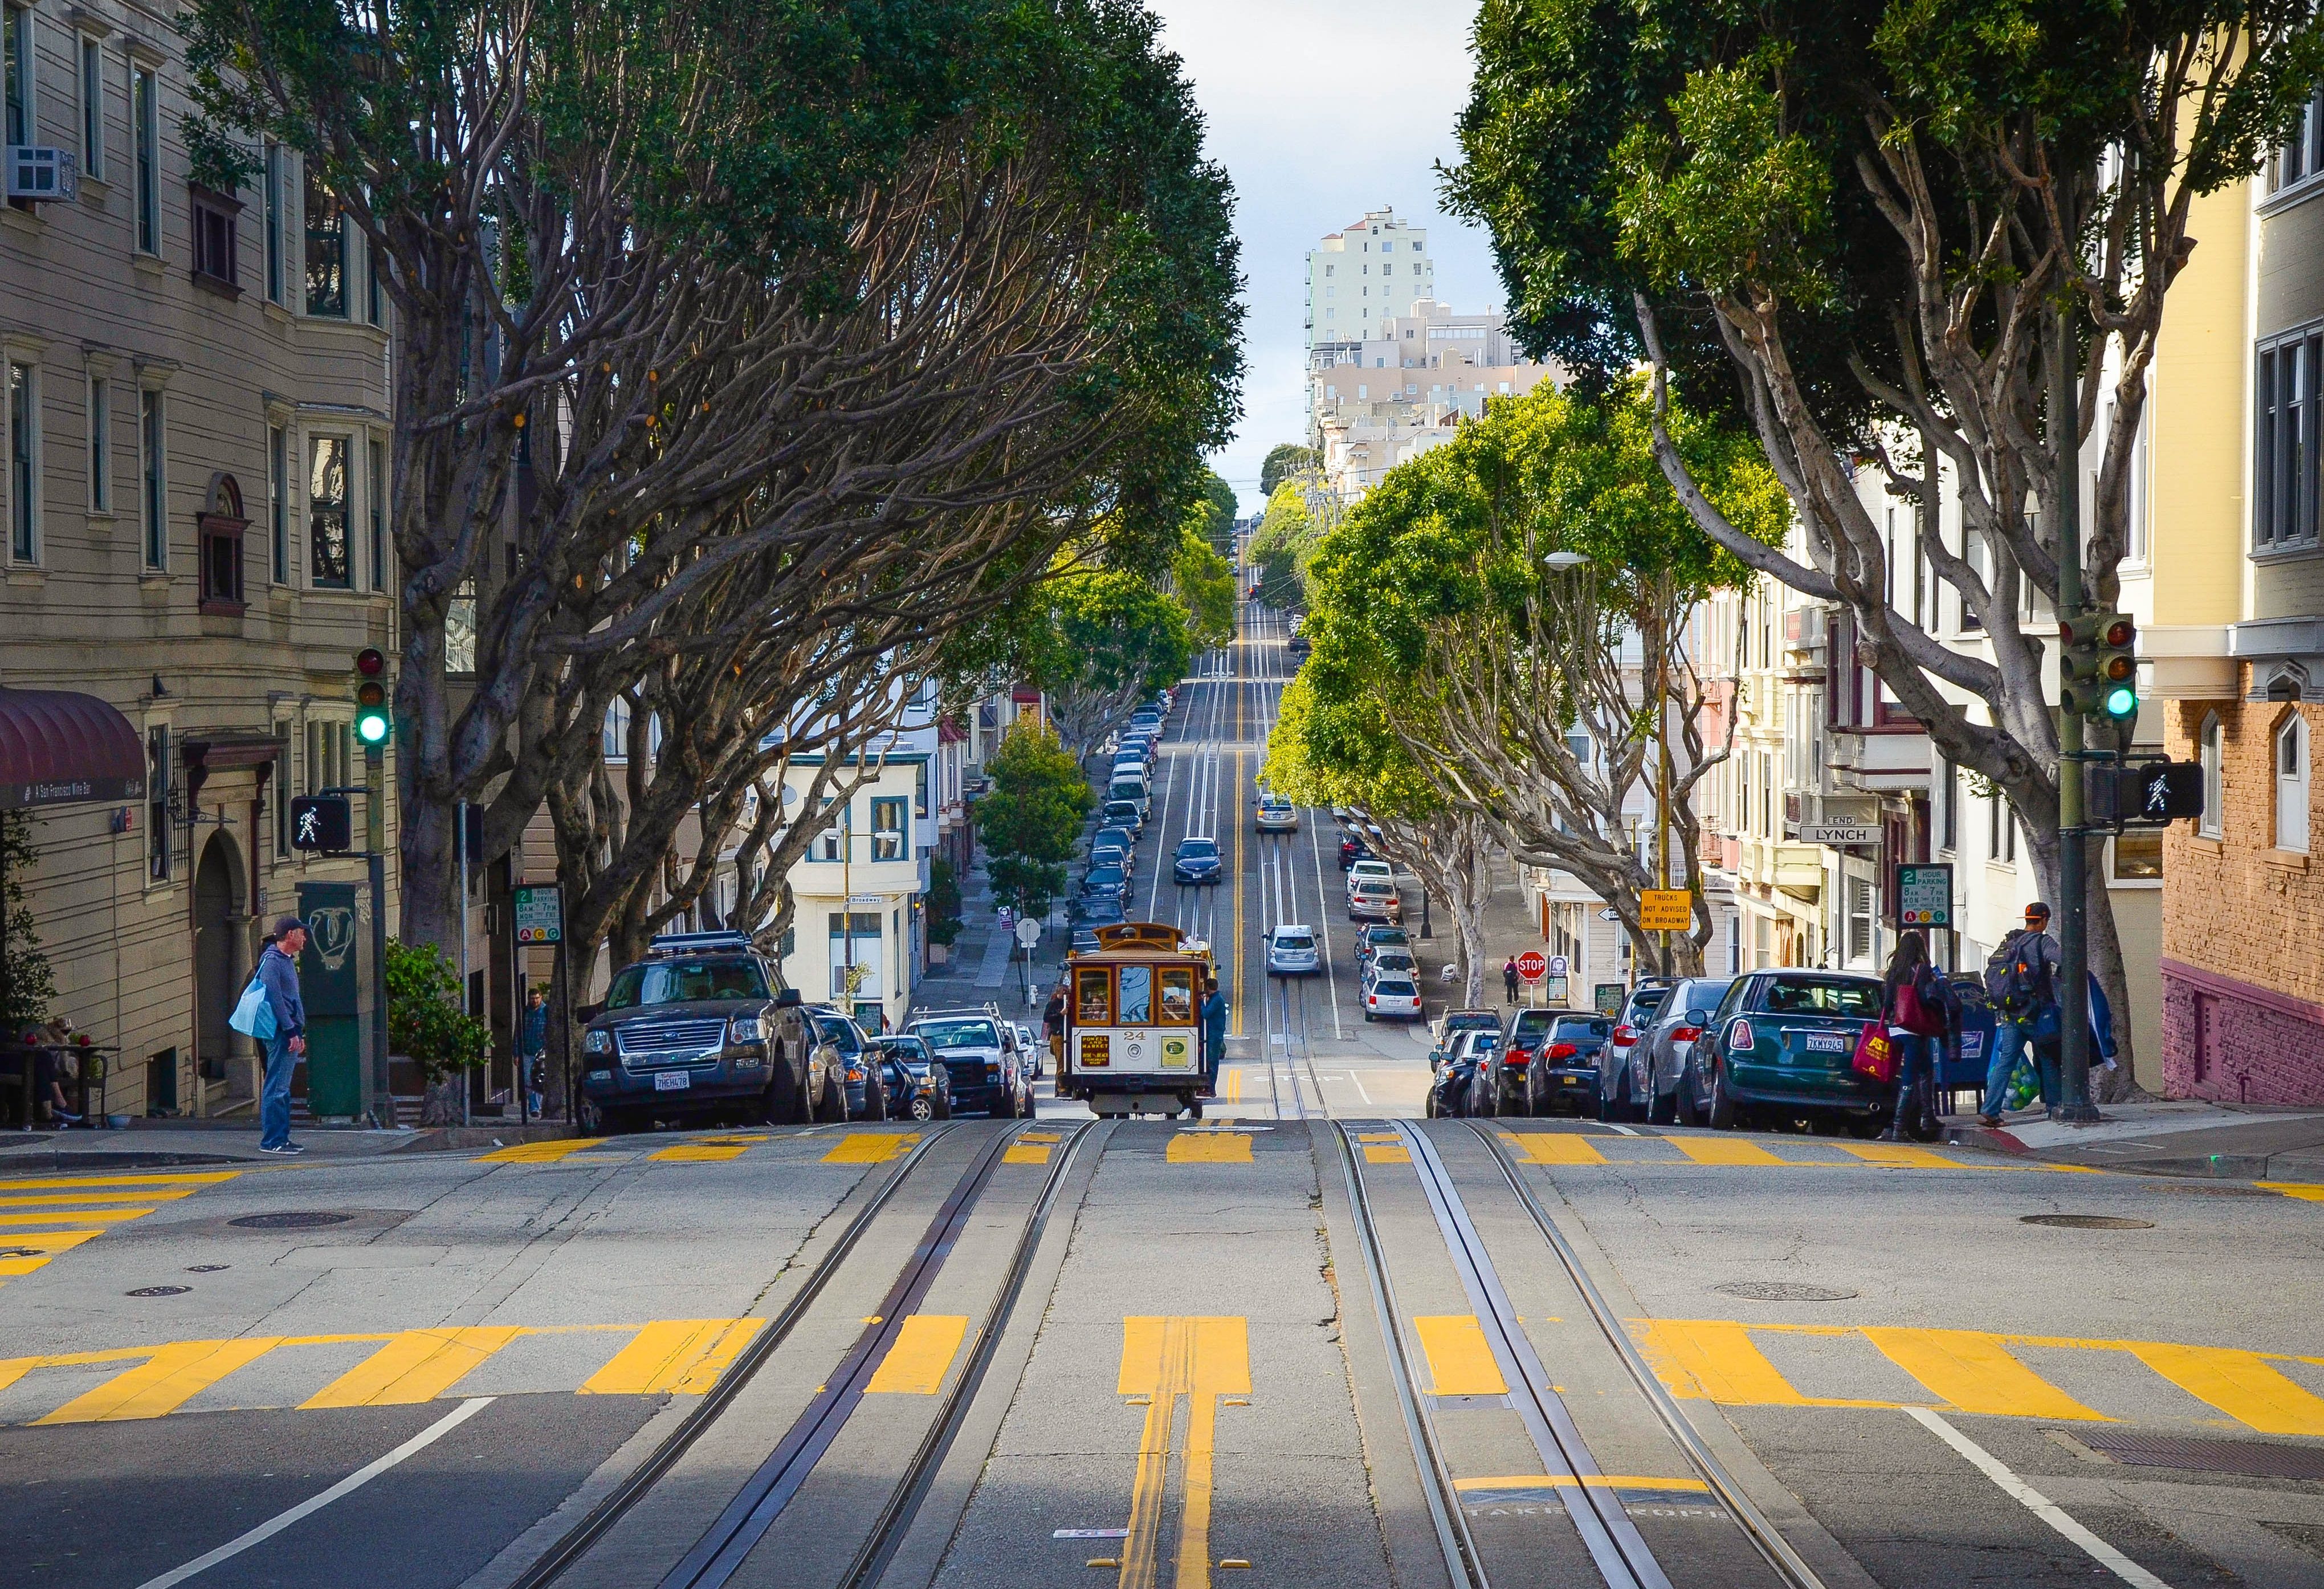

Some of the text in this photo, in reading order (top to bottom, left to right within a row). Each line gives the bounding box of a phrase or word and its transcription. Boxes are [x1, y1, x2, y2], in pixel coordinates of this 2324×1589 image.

[40, 785, 49, 798] San
[50, 784, 71, 796] Francisco
[1816, 830, 1866, 840] LYNCH
[1904, 871, 1914, 883] 2
[520, 891, 527, 902] 2
[1907, 912, 1913, 921] A
[1936, 912, 1942, 921] G
[521, 929, 557, 938] A C G
[1519, 959, 1544, 971] STOP
[1124, 1031, 1146, 1041] 24
[1808, 1039, 1842, 1050] 7KMY945
[657, 1077, 687, 1088] 7HEH478
[1465, 1507, 1730, 1519] TAKE ROPE
